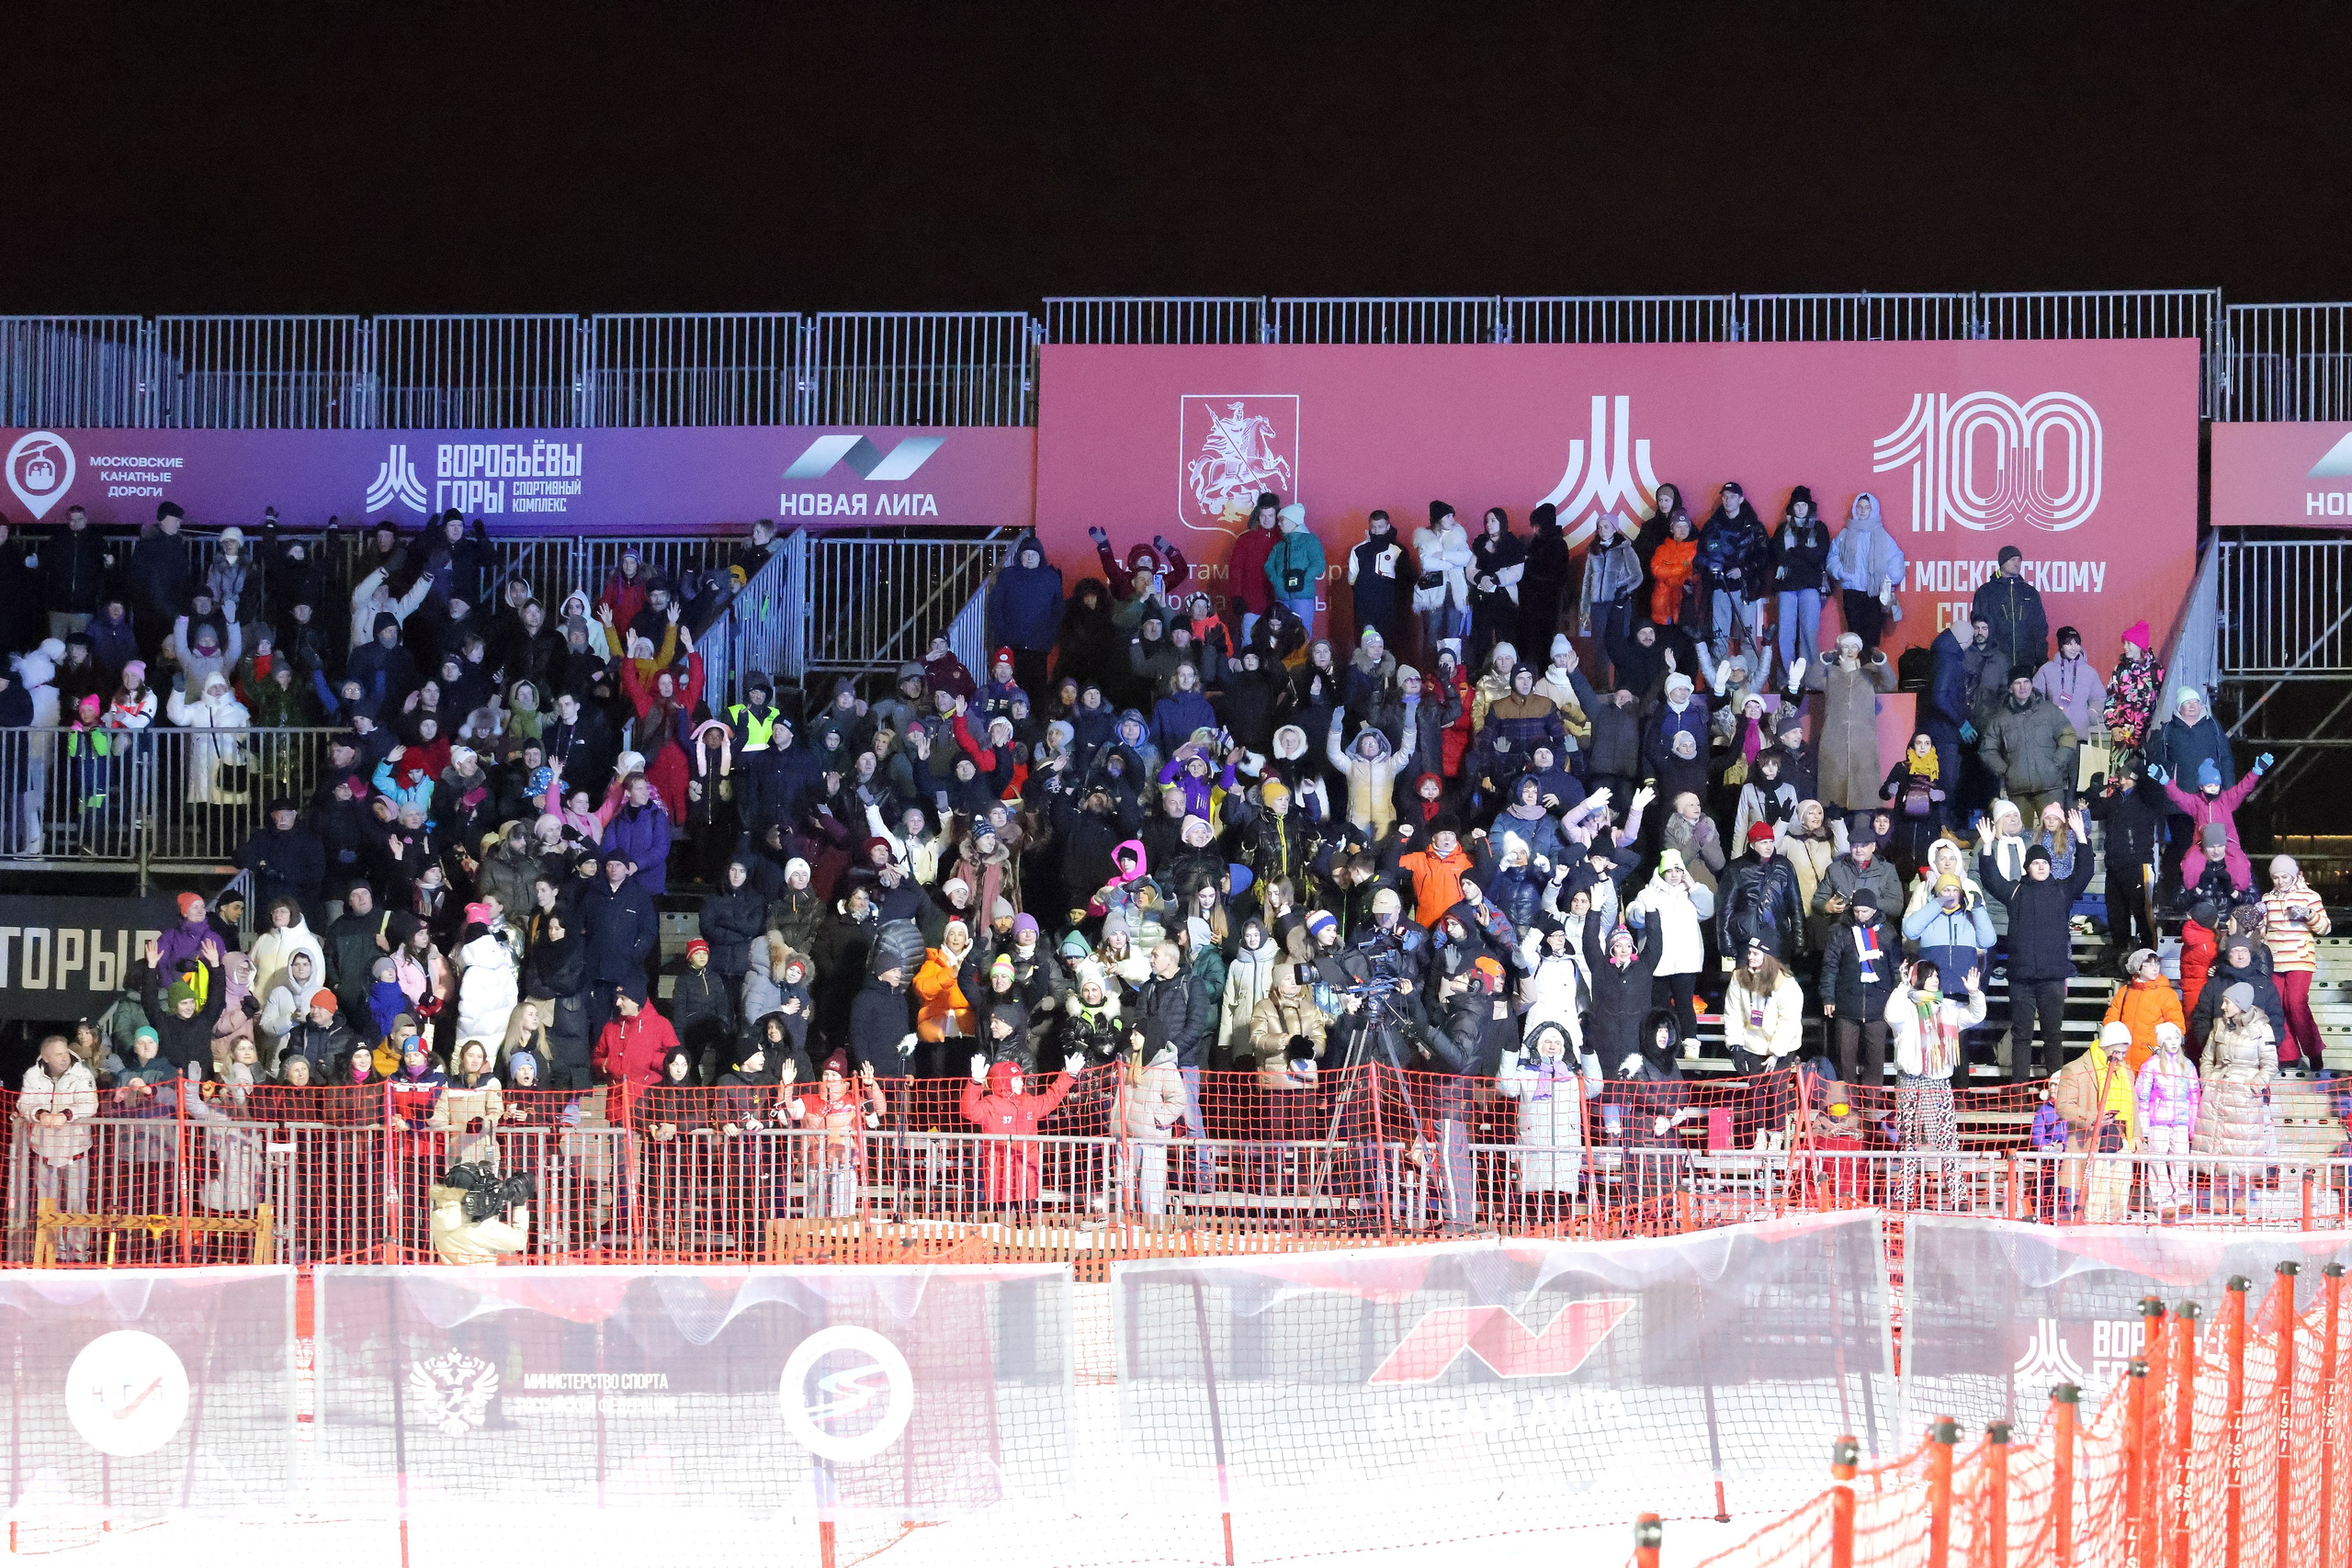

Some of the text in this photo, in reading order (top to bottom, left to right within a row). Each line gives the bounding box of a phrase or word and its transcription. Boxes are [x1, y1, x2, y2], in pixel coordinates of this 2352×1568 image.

[90, 456, 184, 468] МОСКОВСКИЕ
[436, 439, 582, 478] ВОРОБЬЁВЫ
[1873, 391, 2102, 532] 100
[100, 471, 172, 482] КАНАТНЫЕ
[513, 479, 582, 496] СПОРТИВНЫЙ
[107, 486, 163, 498] ДОРОГИ
[436, 480, 504, 513] ГОРЫ
[513, 498, 567, 513] КОМПЛЕКС
[780, 493, 939, 516] НОВАЯ ЛИГА
[1916, 560, 2107, 592] МОСКОСКОМУ
[524, 1373, 669, 1390] МИНИСТЕРСТВО СПОРТА
[2279, 1393, 2290, 1452] LISKI
[2233, 1416, 2243, 1482] LISKI
